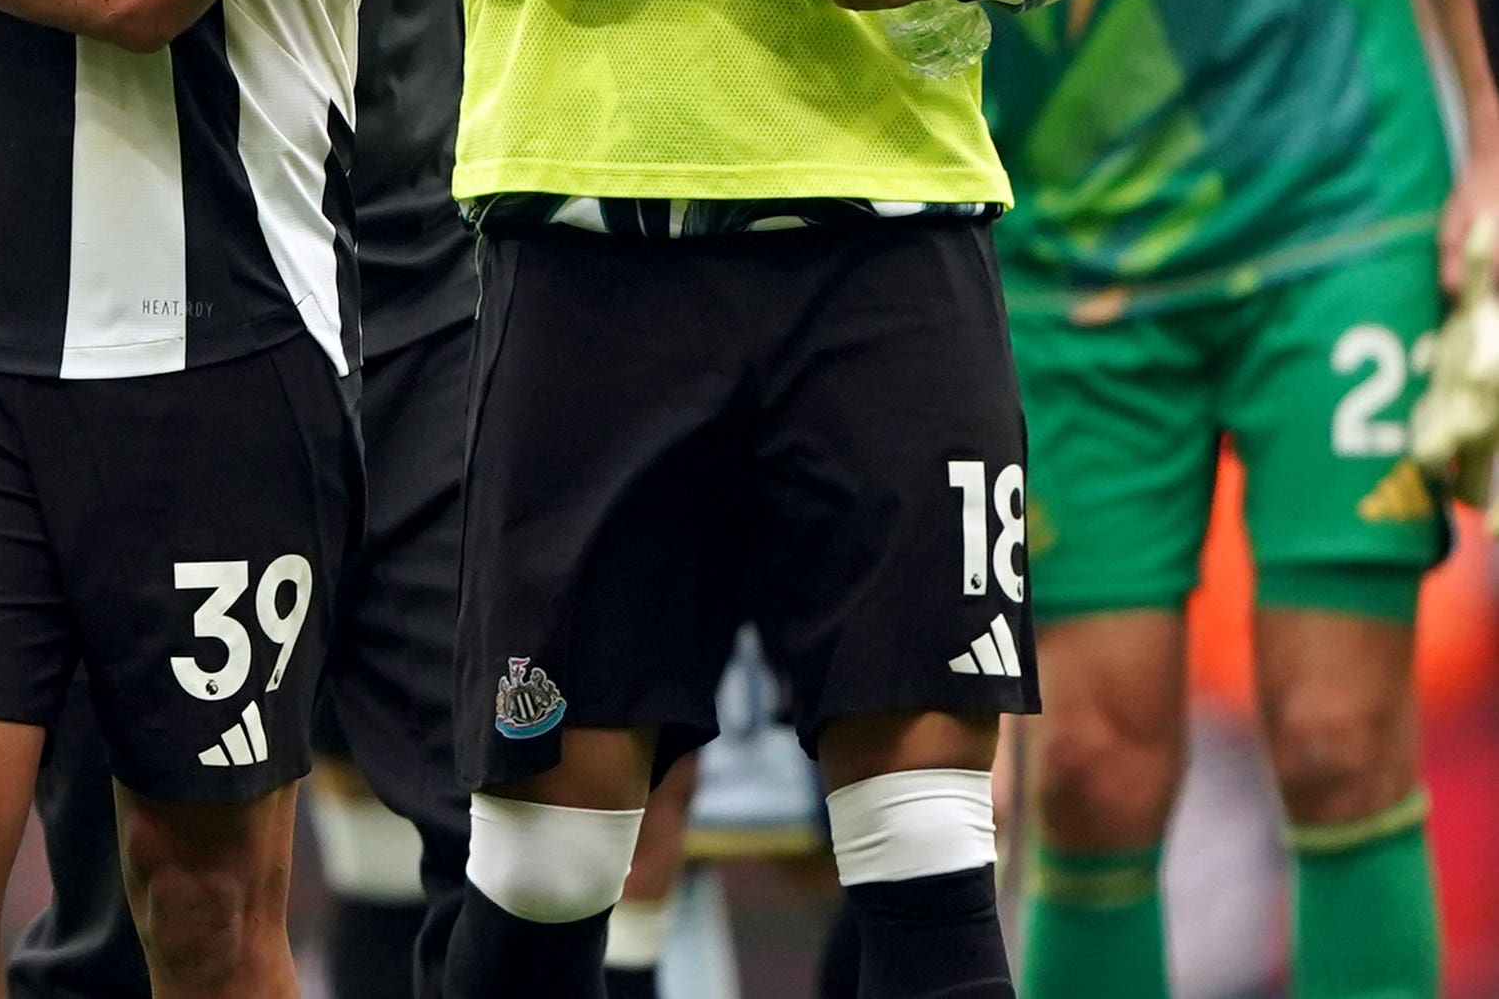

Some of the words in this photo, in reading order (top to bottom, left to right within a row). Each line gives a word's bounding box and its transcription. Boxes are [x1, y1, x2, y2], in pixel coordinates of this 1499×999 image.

[142, 299, 213, 319] HEAT.RDY
[947, 460, 1025, 603] 18
[170, 553, 313, 701] 39
